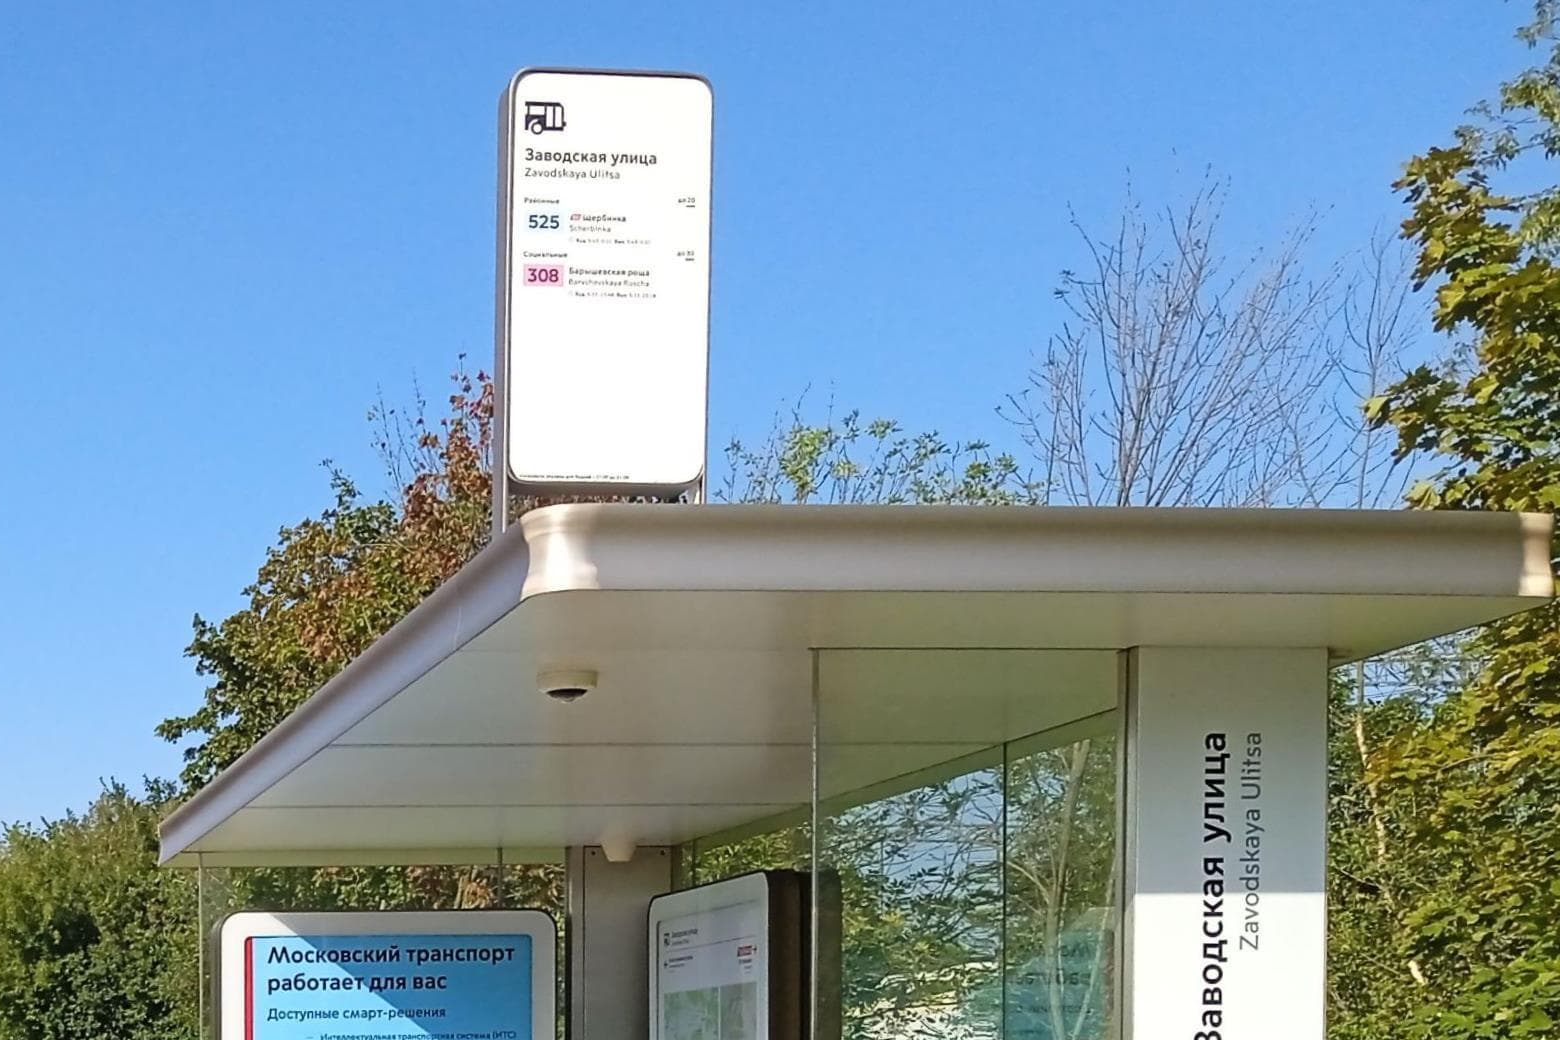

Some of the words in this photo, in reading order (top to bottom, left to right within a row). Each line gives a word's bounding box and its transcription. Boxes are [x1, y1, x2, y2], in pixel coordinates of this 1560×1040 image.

[524, 148, 607, 164] Заводская
[610, 153, 658, 167] улица
[524, 167, 587, 180] Zavodskaya
[589, 168, 621, 180] Ulitsa
[528, 214, 560, 229] 525
[527, 267, 560, 283] 308
[1240, 732, 1262, 800] Ulitsa
[1203, 732, 1233, 843] улица
[1239, 808, 1266, 951] Zavodskaya
[267, 945, 402, 965] Московский
[406, 947, 516, 967] транспорт
[267, 972, 366, 996] работает
[368, 975, 408, 994] для
[412, 975, 448, 990] вас
[266, 1007, 340, 1023] Доступные
[342, 1007, 447, 1021] смарт-решения
